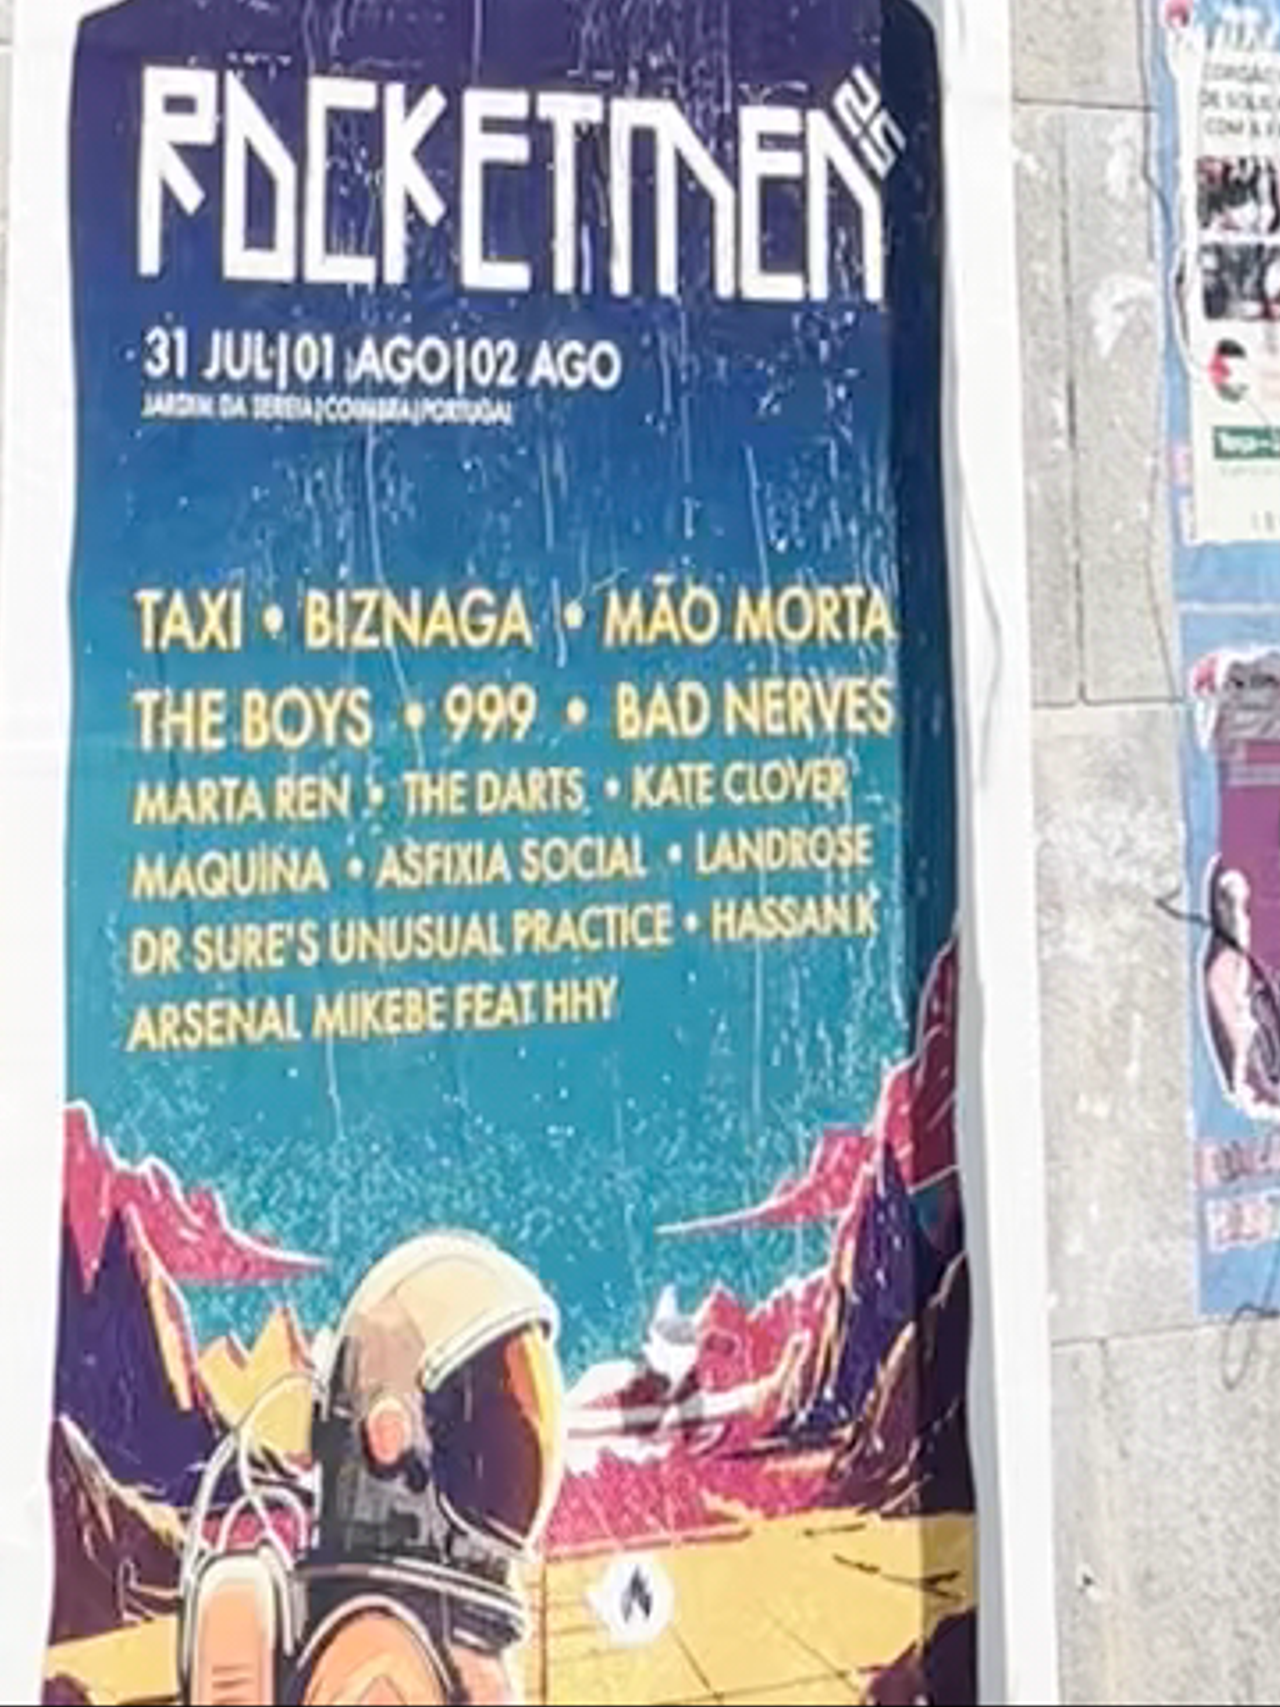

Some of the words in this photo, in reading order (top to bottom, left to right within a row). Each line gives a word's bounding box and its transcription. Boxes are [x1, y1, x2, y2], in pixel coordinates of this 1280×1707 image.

[144, 326, 188, 378] 31
[527, 339, 622, 390] AGO
[134, 588, 243, 651] TAXI
[305, 587, 534, 650] BIZNAGA
[604, 573, 720, 647] MÃO
[734, 585, 896, 643] MORTA
[134, 688, 226, 751] THE
[242, 686, 374, 750] BOYS
[444, 682, 537, 743] 999
[616, 681, 710, 740] BAD
[723, 678, 895, 740] NERVES
[133, 775, 265, 826] MARTA
[276, 772, 351, 819] REN
[402, 770, 467, 817] THE
[476, 765, 585, 815] DARTS
[631, 762, 716, 810] KATE
[722, 757, 850, 806] CLOVER
[131, 845, 329, 900] MAQUINA
[375, 838, 513, 890] ASFIXIA
[520, 832, 647, 883] SOCIAL
[696, 824, 875, 875] LANDROSE
[130, 927, 182, 975] DR
[192, 919, 320, 973] SURE'S
[329, 911, 505, 964] UNUSUAL
[511, 902, 674, 954] PRACTICE
[126, 993, 302, 1052] ARSENAL
[312, 984, 447, 1039] MIKEBE
[455, 979, 536, 1028] FEAT
[545, 975, 618, 1023] HHY
